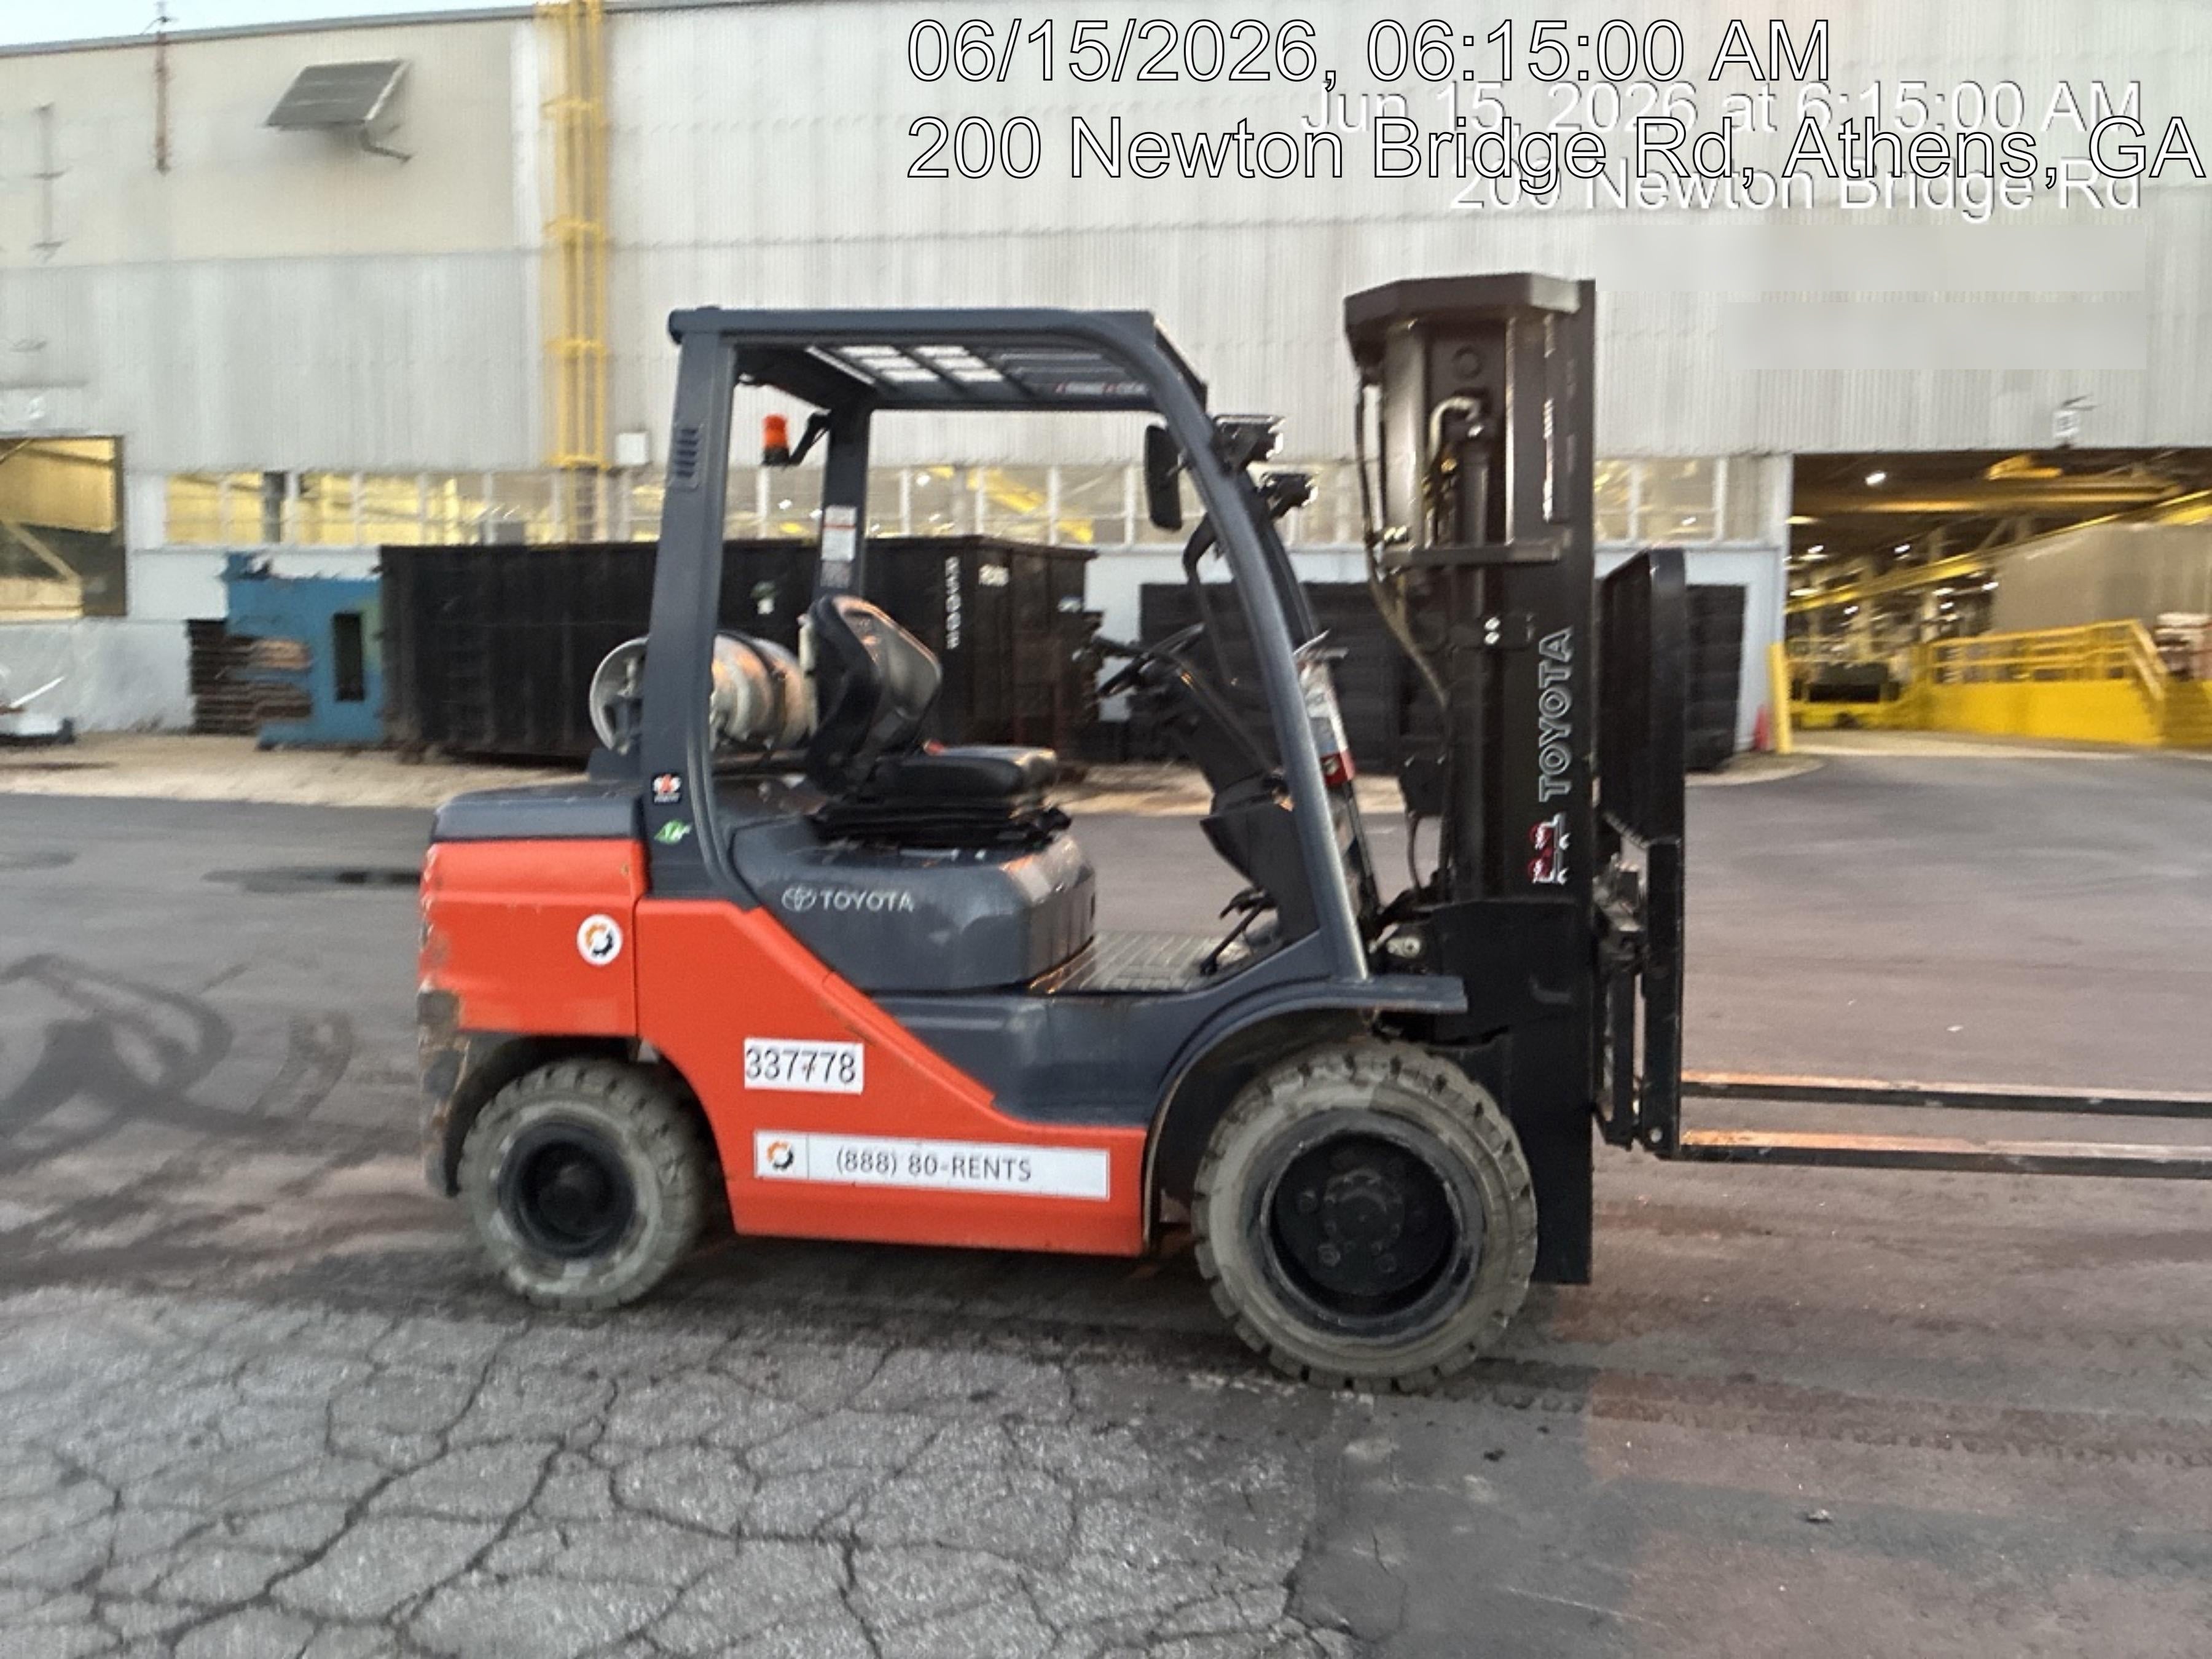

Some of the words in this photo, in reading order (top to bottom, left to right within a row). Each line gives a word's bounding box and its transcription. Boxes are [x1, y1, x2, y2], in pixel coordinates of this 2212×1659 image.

[1539, 624, 1574, 803] TOYOTA
[820, 890, 915, 913] TOYOTA
[745, 1046, 856, 1084] 337778
[836, 1145, 897, 1175] (888)
[908, 1150, 1032, 1182] 80-RENTS
